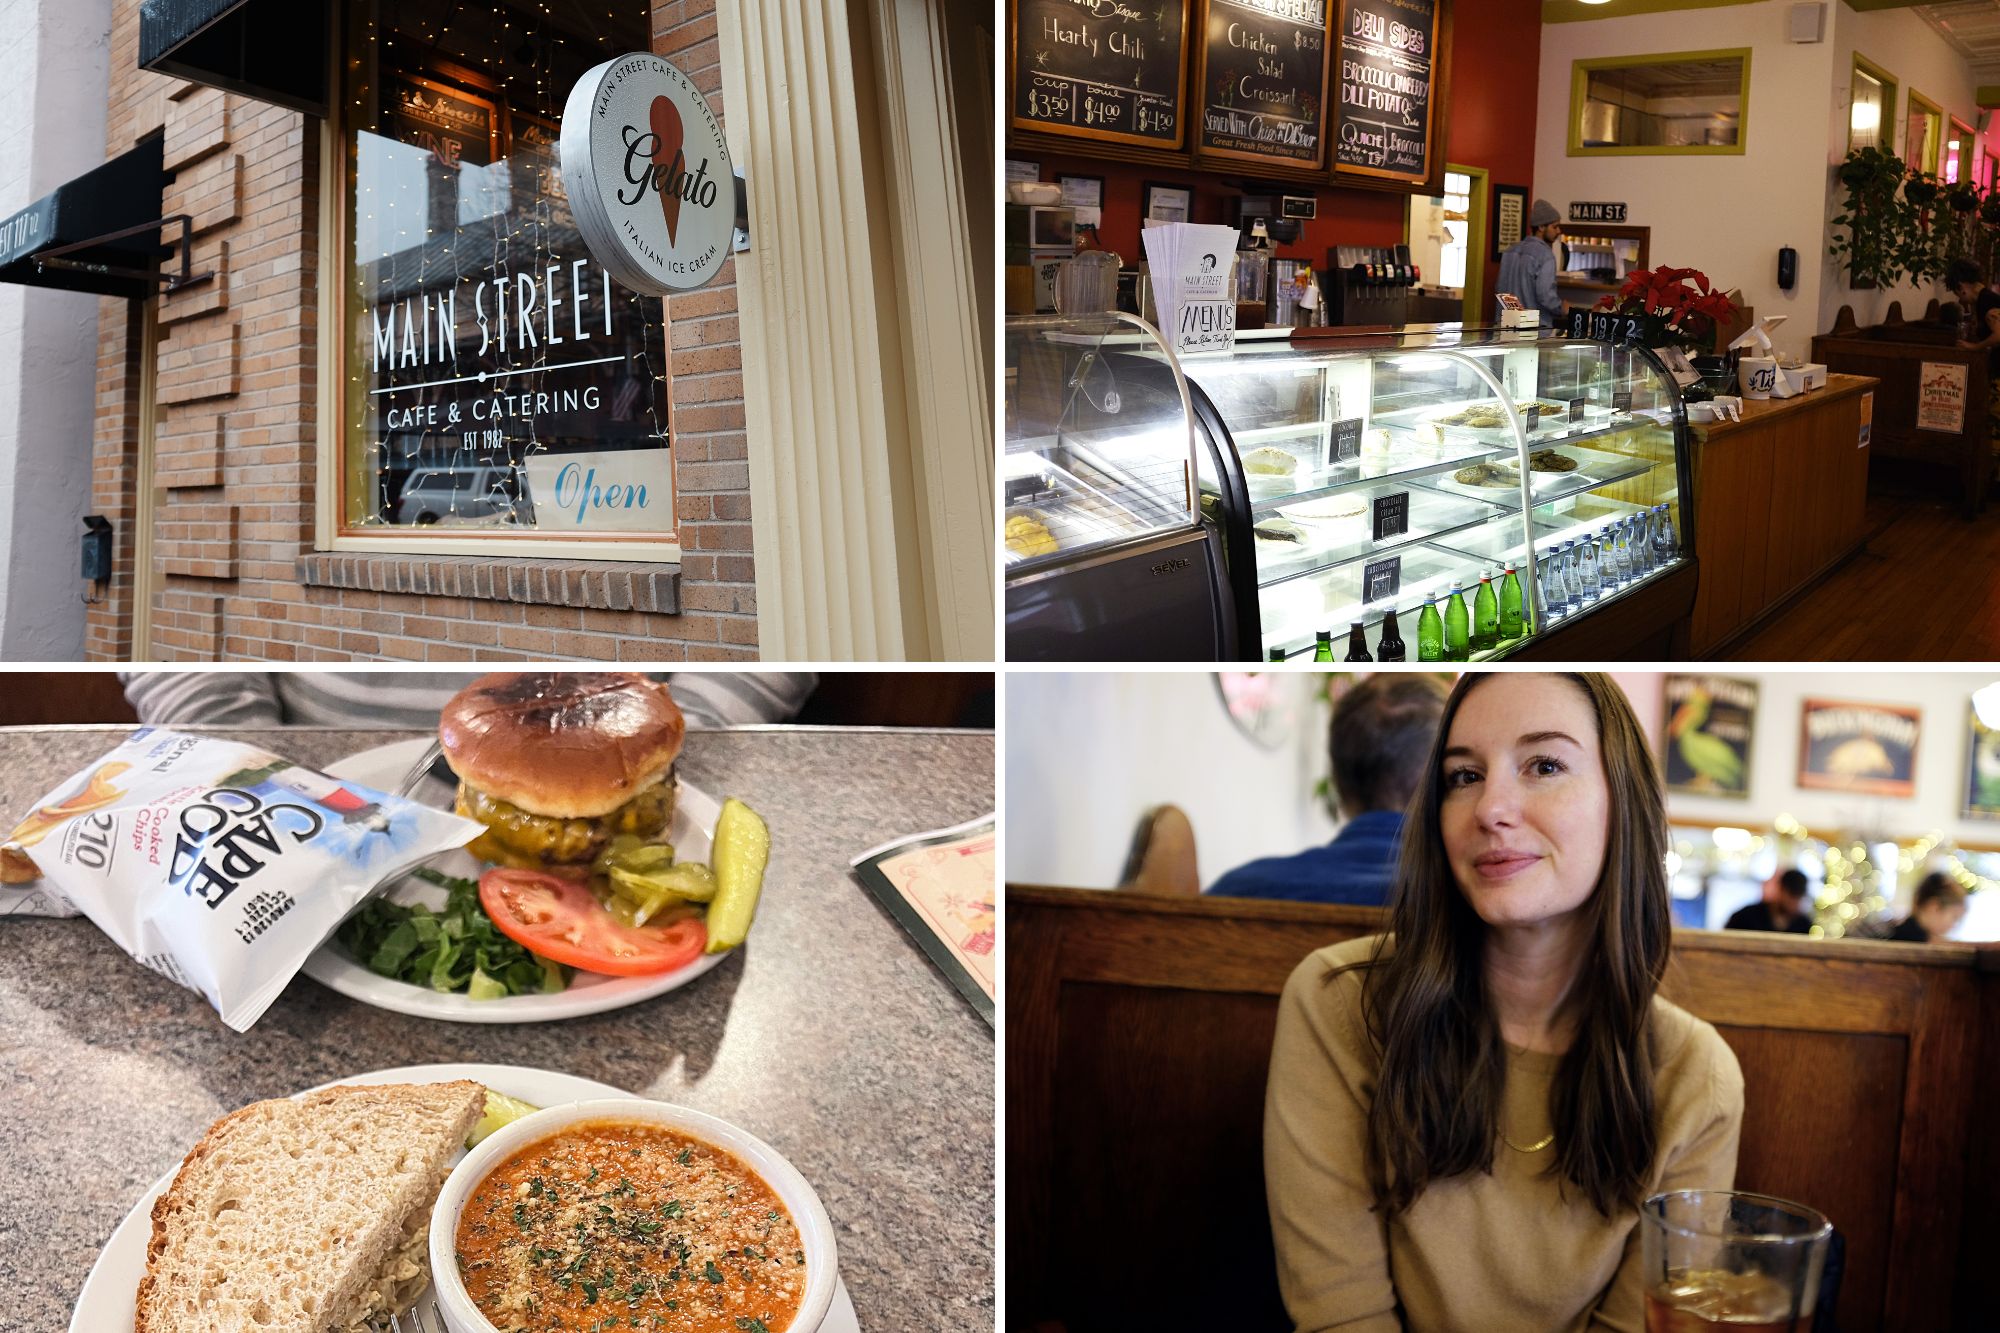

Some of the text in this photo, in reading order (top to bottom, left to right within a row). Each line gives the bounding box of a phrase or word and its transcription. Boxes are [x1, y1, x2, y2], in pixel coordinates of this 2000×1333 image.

[1043, 16, 1145, 60] Hearty Chili
[1228, 22, 1278, 55] Chicken
[1352, 8, 1385, 42] DELI
[1389, 21, 1425, 54] SIDES
[1239, 75, 1296, 106] Croissant
[1257, 57, 1284, 80] Salad
[598, 60, 727, 161] MAIN STREET CAFE & CATERING
[1342, 83, 1367, 108] DILL
[617, 124, 717, 209] Gelato
[1212, 136, 1233, 147] Great
[1235, 139, 1256, 151] Fresh
[1256, 142, 1274, 153] Food
[1572, 204, 1623, 219] MAIN ST.
[624, 219, 717, 274] ITALIAN ICE CREAM
[1202, 275, 1223, 286] STREET
[373, 258, 613, 374] MAIN STREET
[1181, 304, 1233, 333] MENUS
[387, 386, 601, 430] CAFE & CATERING
[463, 430, 503, 451] EST 1982
[554, 462, 650, 524] Open
[75, 813, 113, 869] 210
[132, 808, 151, 853] Chips
[149, 807, 170, 866] Cooked
[168, 788, 264, 898] COD
[195, 803, 324, 911] CAPE
